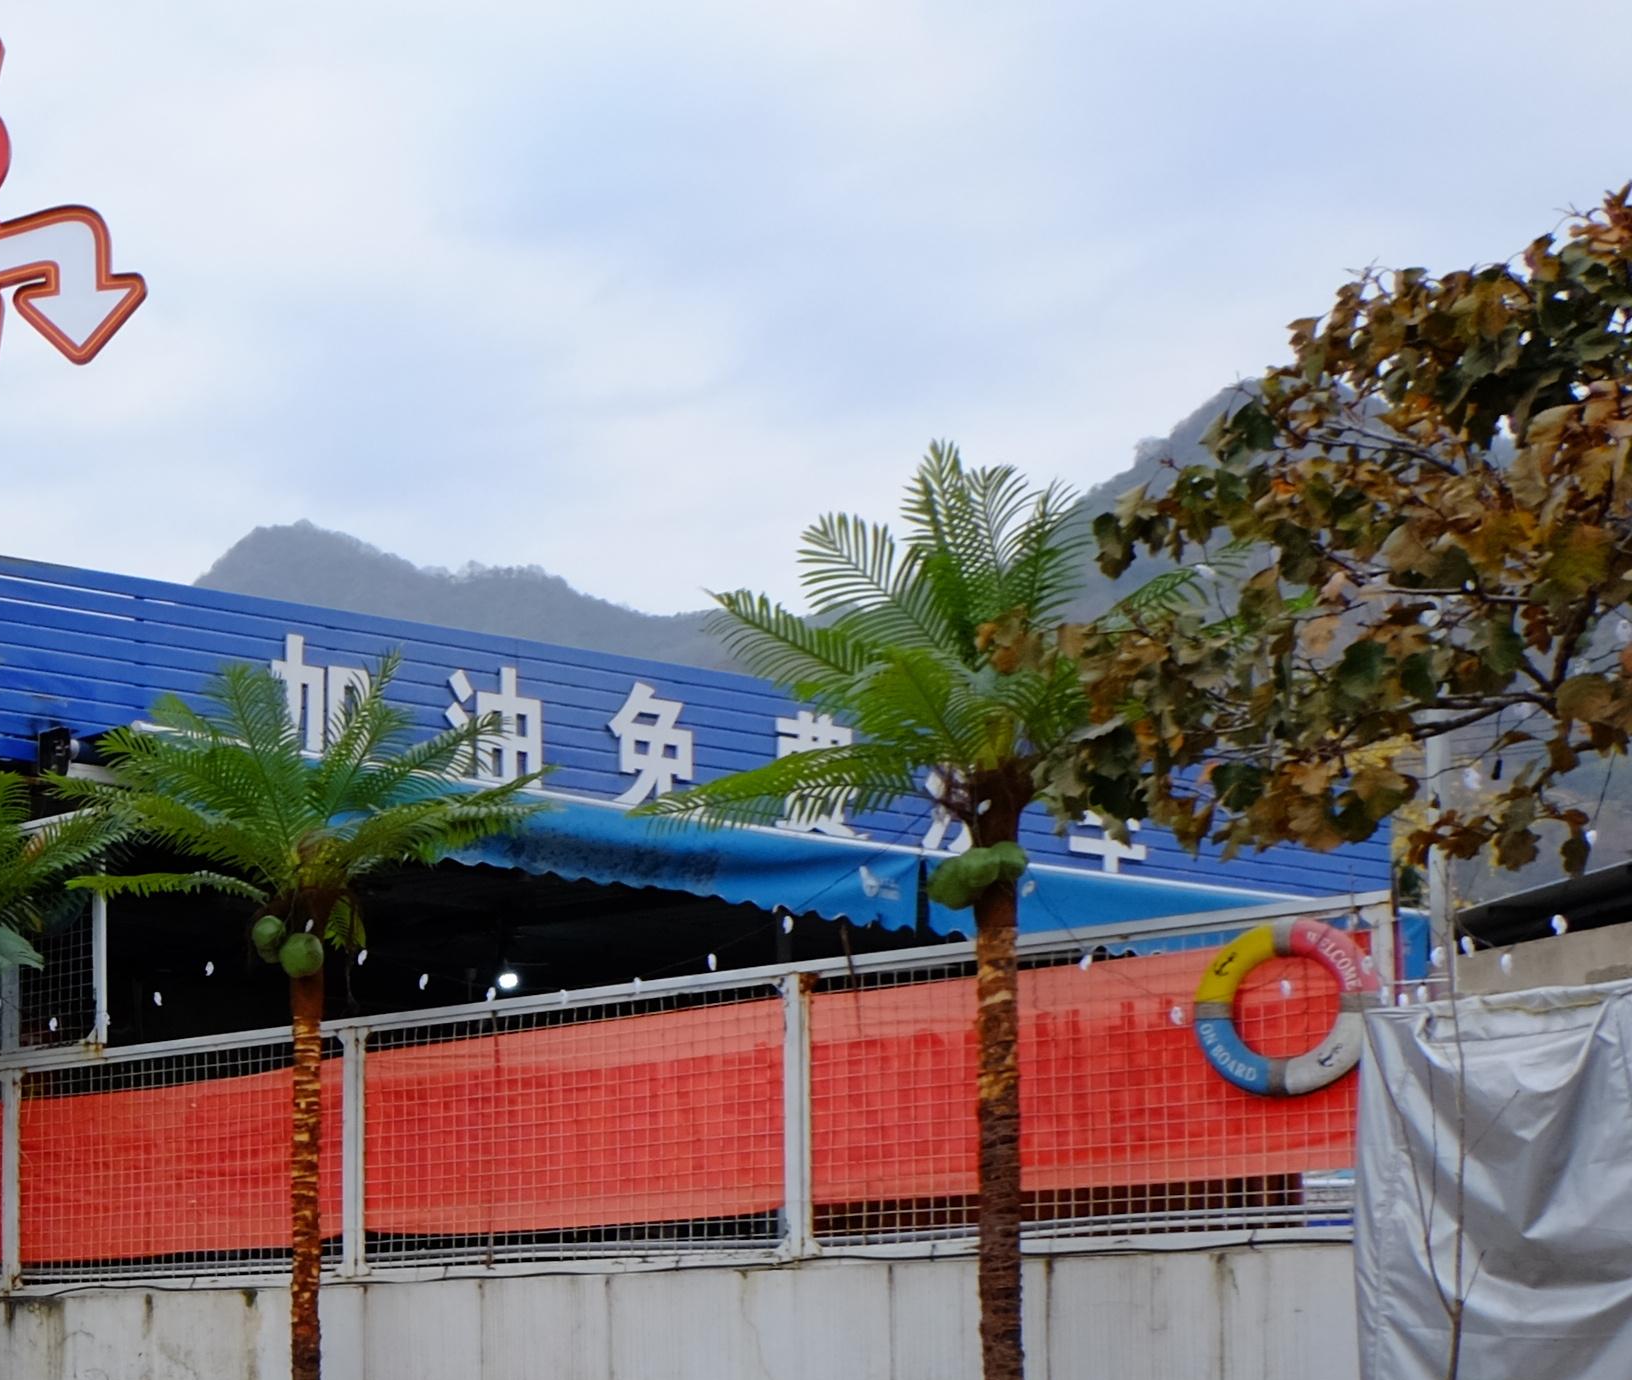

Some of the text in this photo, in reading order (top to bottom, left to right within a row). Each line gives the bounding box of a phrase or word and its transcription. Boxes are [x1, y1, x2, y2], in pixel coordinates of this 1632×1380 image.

[1306, 930, 1360, 993] WELCOME
[1200, 1021, 1257, 1083] ON BOARD
